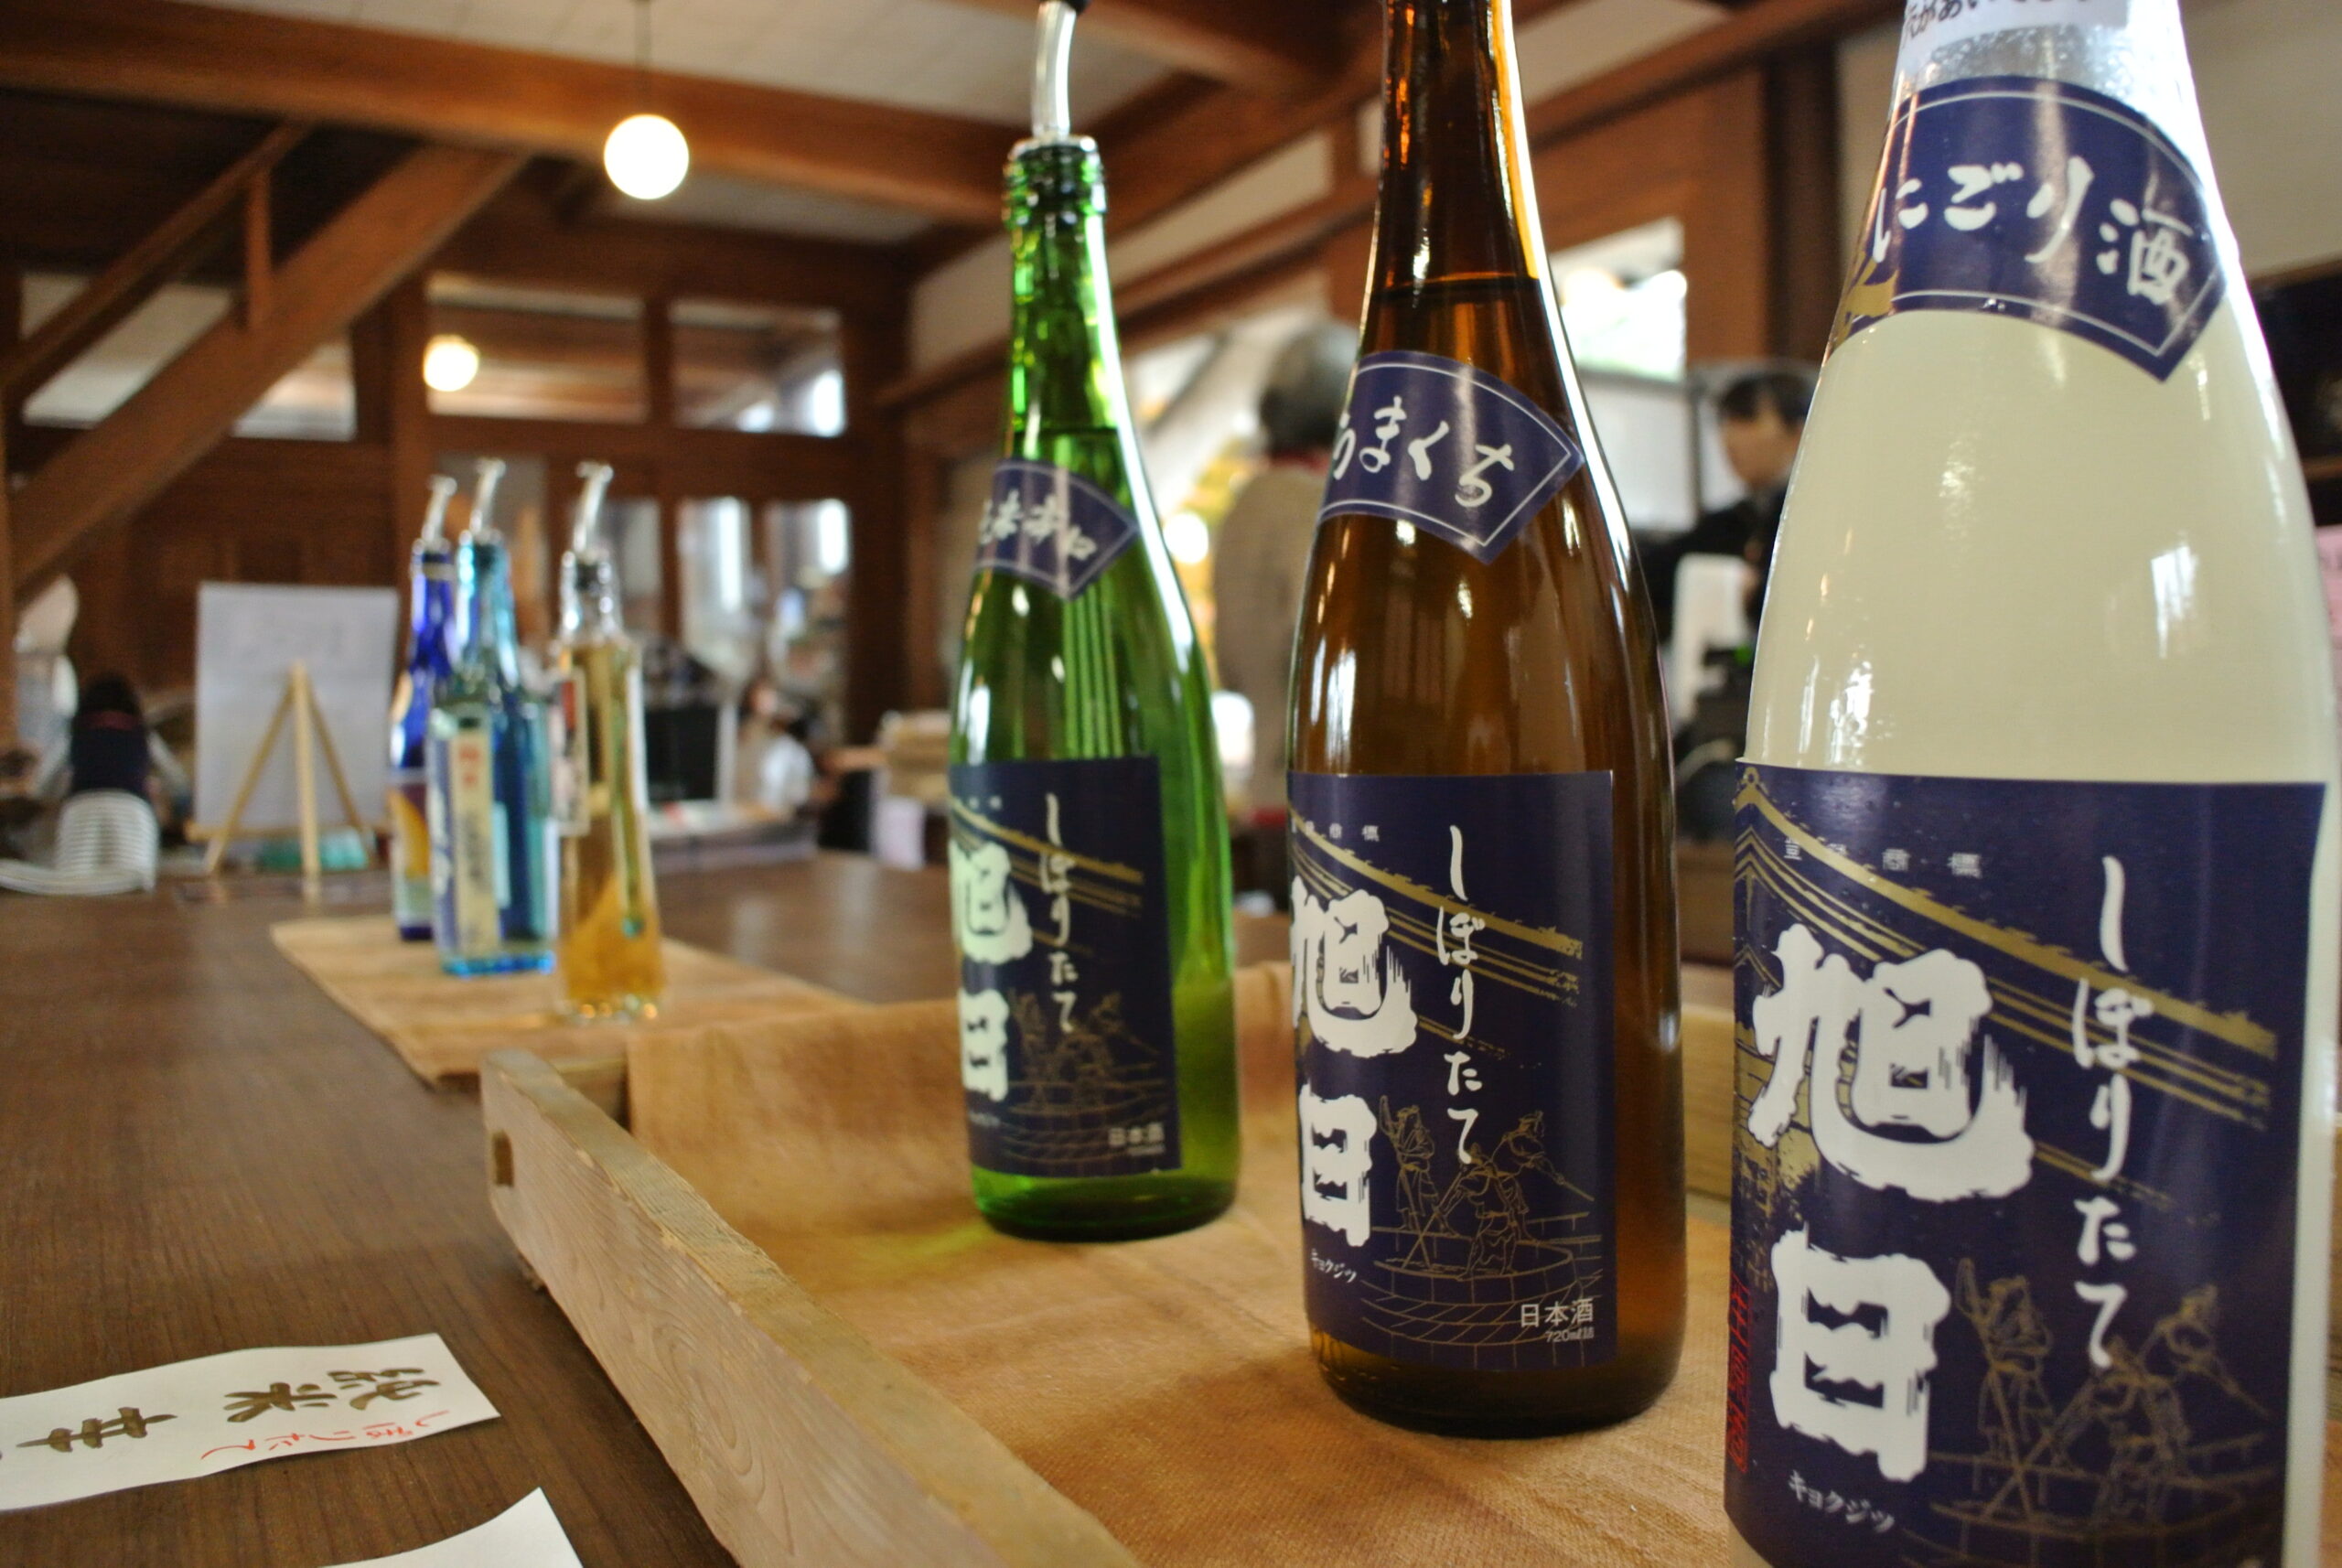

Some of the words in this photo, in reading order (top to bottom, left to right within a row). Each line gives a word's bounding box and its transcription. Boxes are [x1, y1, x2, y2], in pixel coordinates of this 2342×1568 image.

[1873, 156, 2196, 305] にごり酒
[1039, 792, 1080, 1034] しぼりたて
[1436, 824, 1486, 1165] しぼりたて
[1748, 923, 2035, 1483] 旭日
[2072, 855, 2154, 1369] しぼりたて
[1520, 1297, 1594, 1327] 日本酒
[1788, 1468, 1896, 1533] キョクジツ
